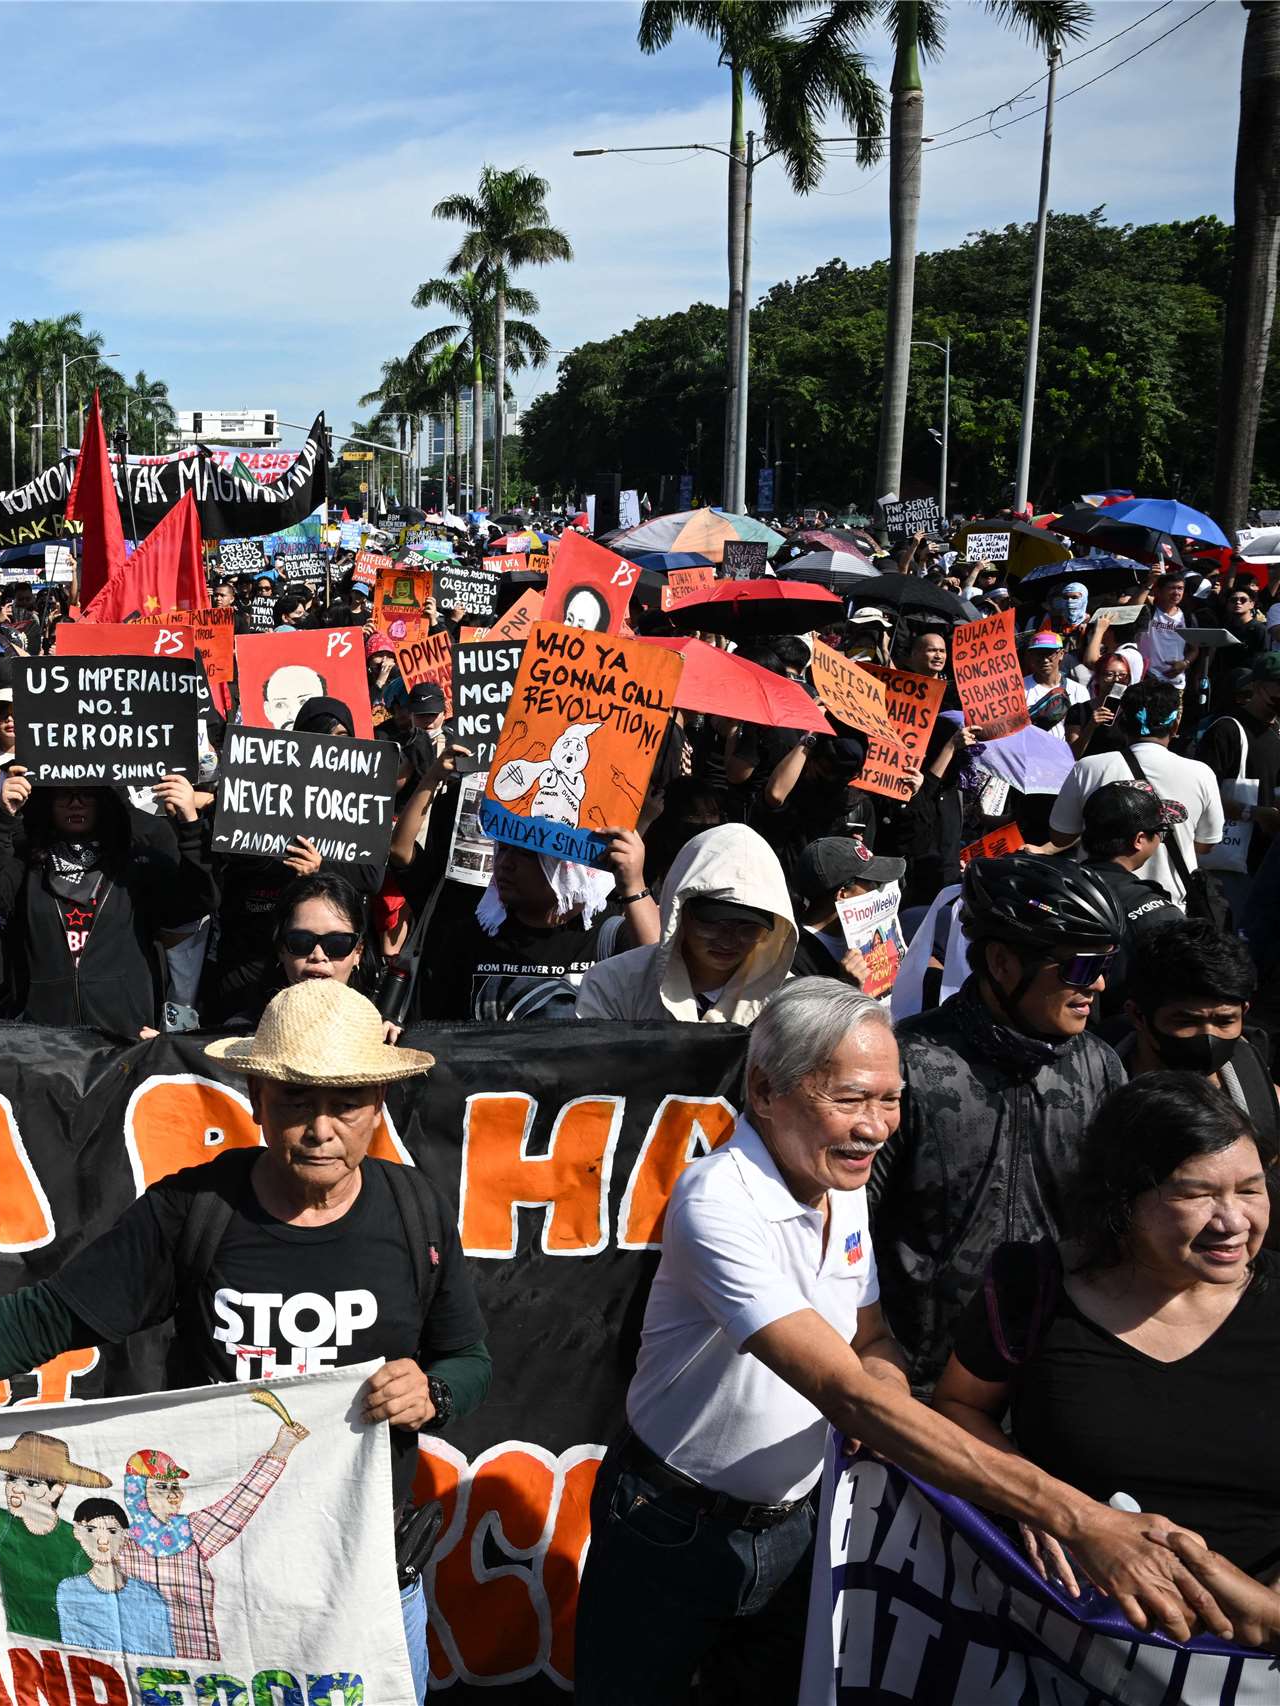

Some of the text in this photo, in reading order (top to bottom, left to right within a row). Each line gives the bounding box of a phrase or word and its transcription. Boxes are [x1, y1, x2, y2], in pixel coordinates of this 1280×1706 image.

[111, 464, 168, 504] ATAK
[886, 506, 940, 524] AND PROTECT
[905, 497, 935, 512] SERVE
[887, 519, 939, 535] THE PEOPLE
[610, 560, 637, 586] PS
[454, 591, 491, 605] HINDI
[154, 629, 184, 655] PS
[327, 631, 353, 657] PS
[956, 619, 1006, 646] BUWAYA
[399, 631, 451, 676] DPWH
[458, 650, 522, 675] HUST
[536, 628, 629, 674] WHO YA
[970, 643, 989, 660] SA
[26, 666, 196, 695] US IMPERIALIST
[813, 648, 883, 707] HUSTISYA
[955, 653, 1017, 685] KONGRESO
[530, 658, 671, 713] GONNA CALL
[961, 675, 1023, 706] SIBAKIN SA
[458, 713, 491, 737] NG
[523, 685, 663, 757] REVOLUTION!
[28, 722, 176, 752] TERRORIST
[229, 734, 382, 779] NEVER AGAIN!
[224, 782, 391, 826] NEVER FORGET
[480, 809, 606, 862] PANDAY SININ
[477, 963, 500, 972] ROM
[502, 963, 519, 973] THE
[521, 964, 549, 974] RIVER
[551, 966, 565, 975] TO
[213, 1287, 378, 1347] STOP
